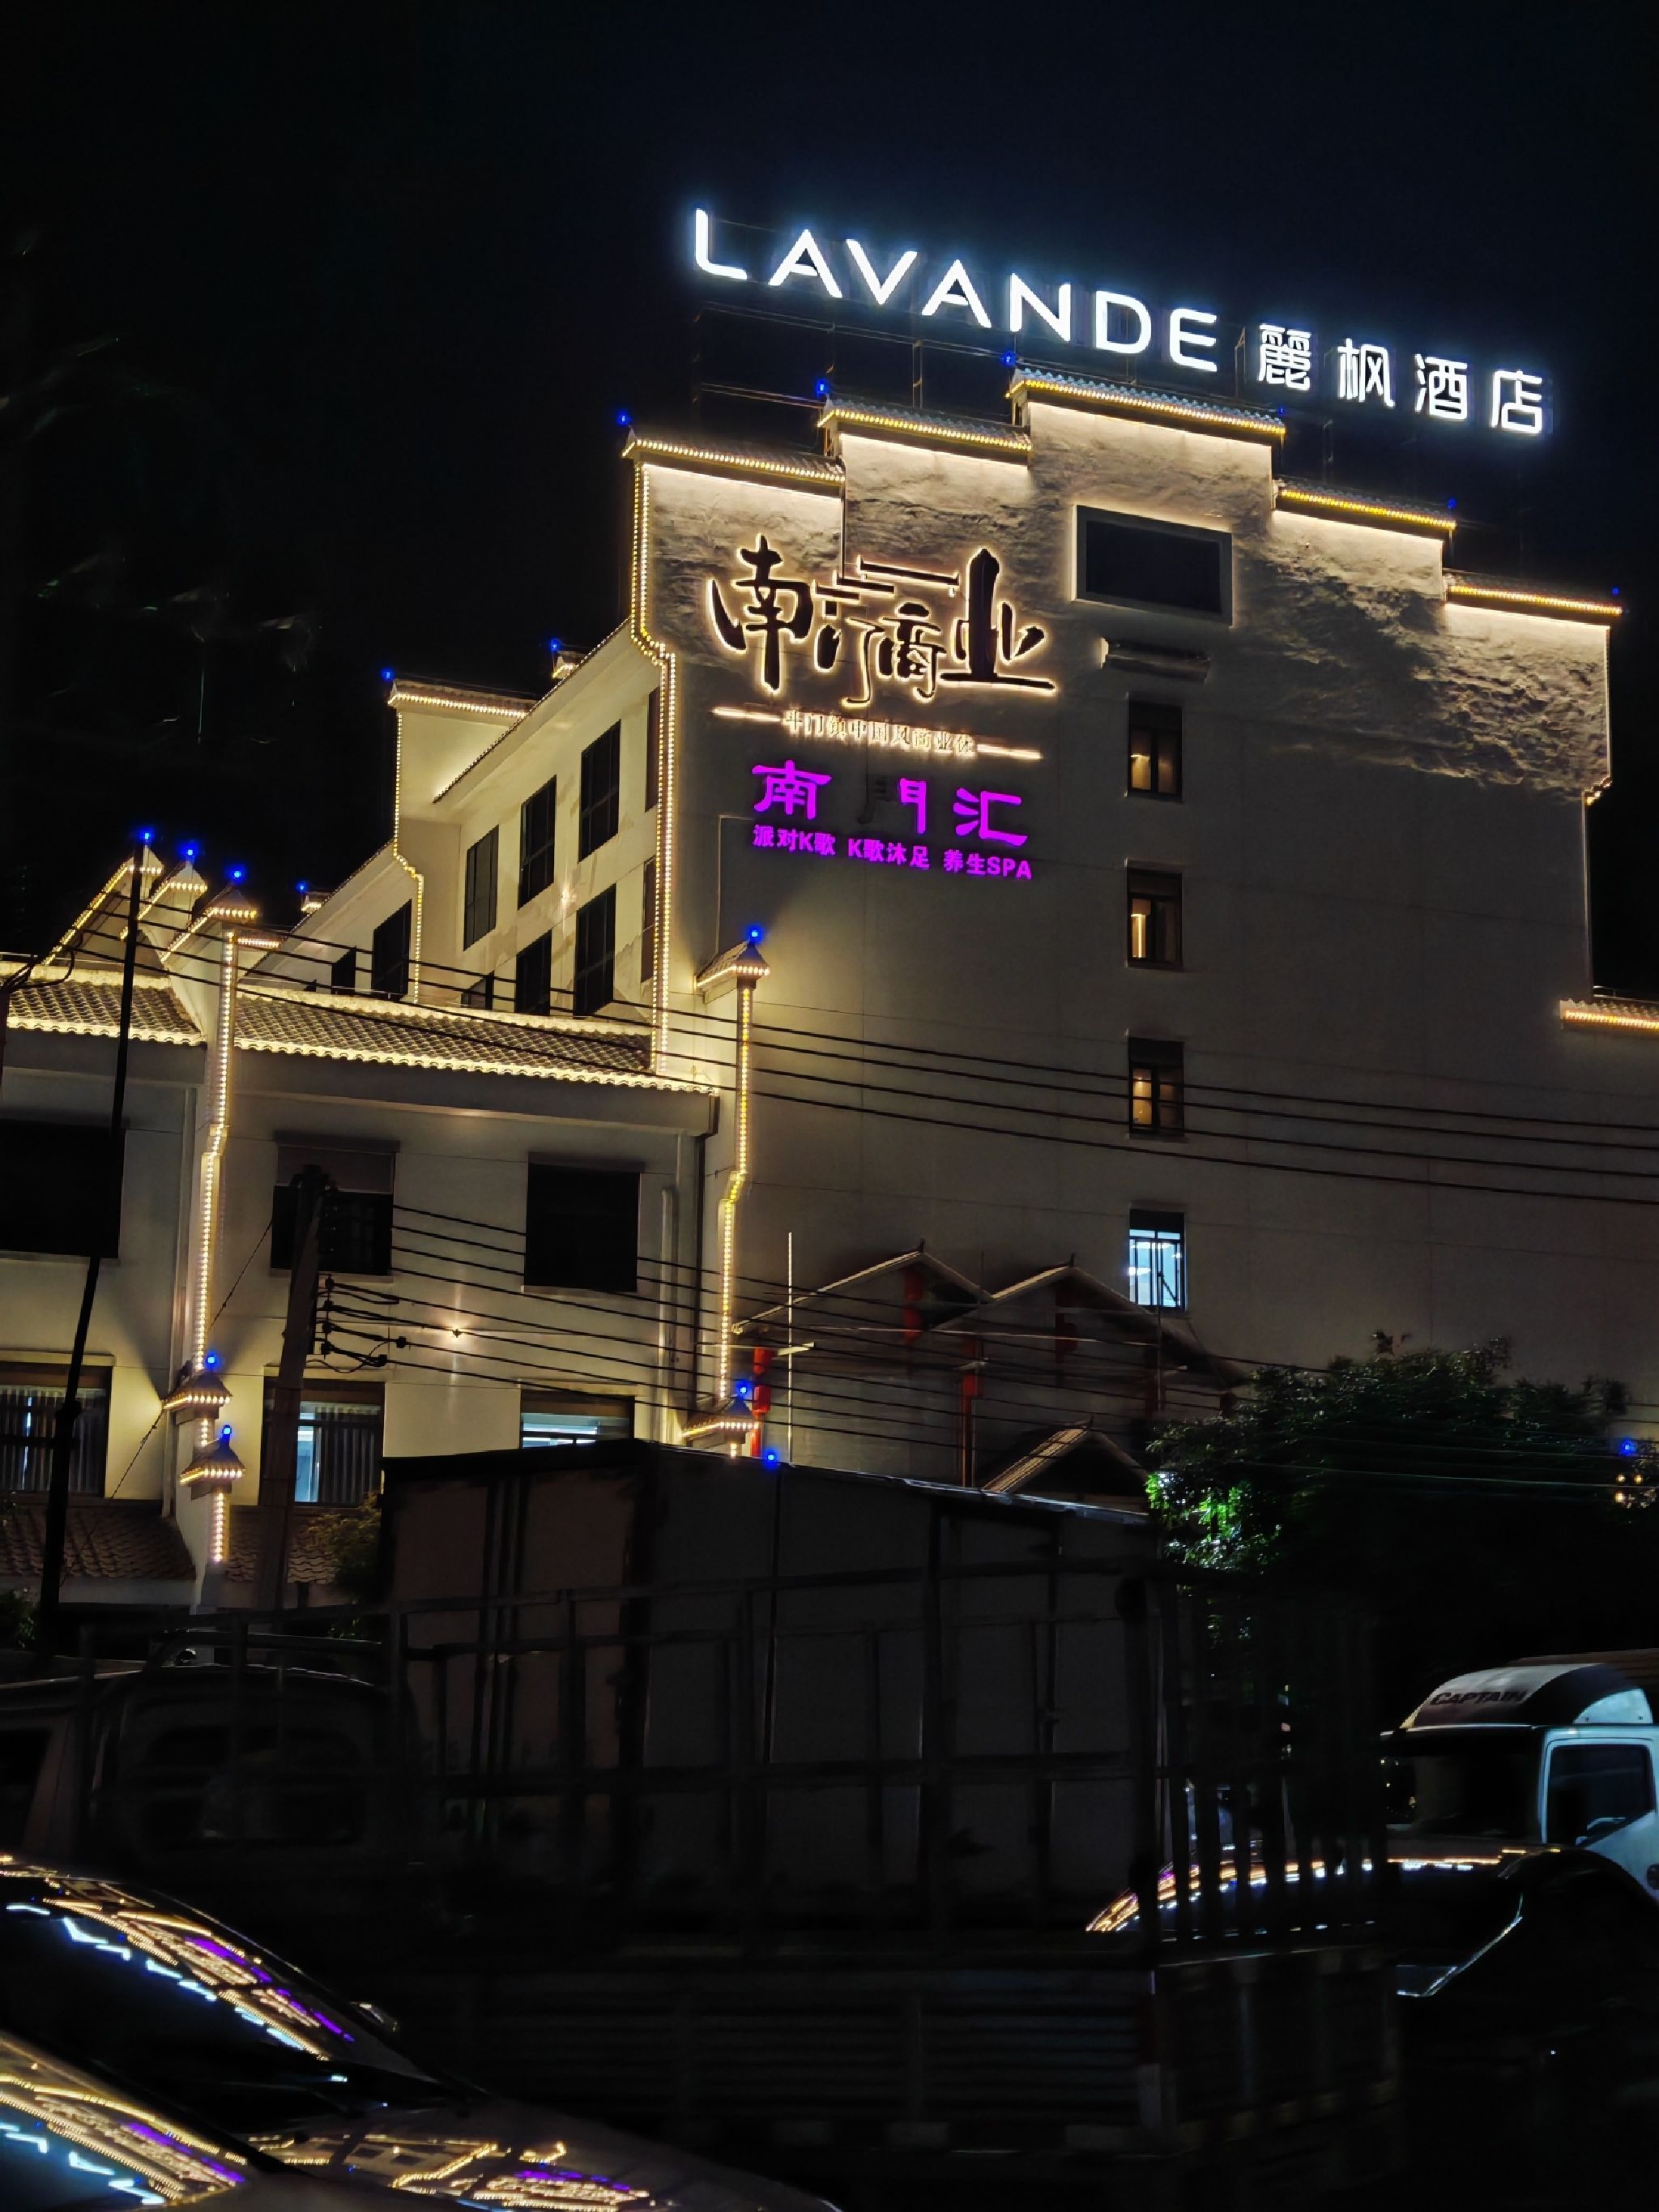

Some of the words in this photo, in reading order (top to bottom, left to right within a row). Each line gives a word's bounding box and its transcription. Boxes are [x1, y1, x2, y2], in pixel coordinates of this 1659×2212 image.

[695, 207, 1218, 373] LAVANDE
[753, 824, 836, 856] 派对K歌
[848, 838, 930, 870] K歌沐足
[943, 849, 1032, 880] 养生SPA
[1430, 1691, 1529, 1706] CAPTAIN
